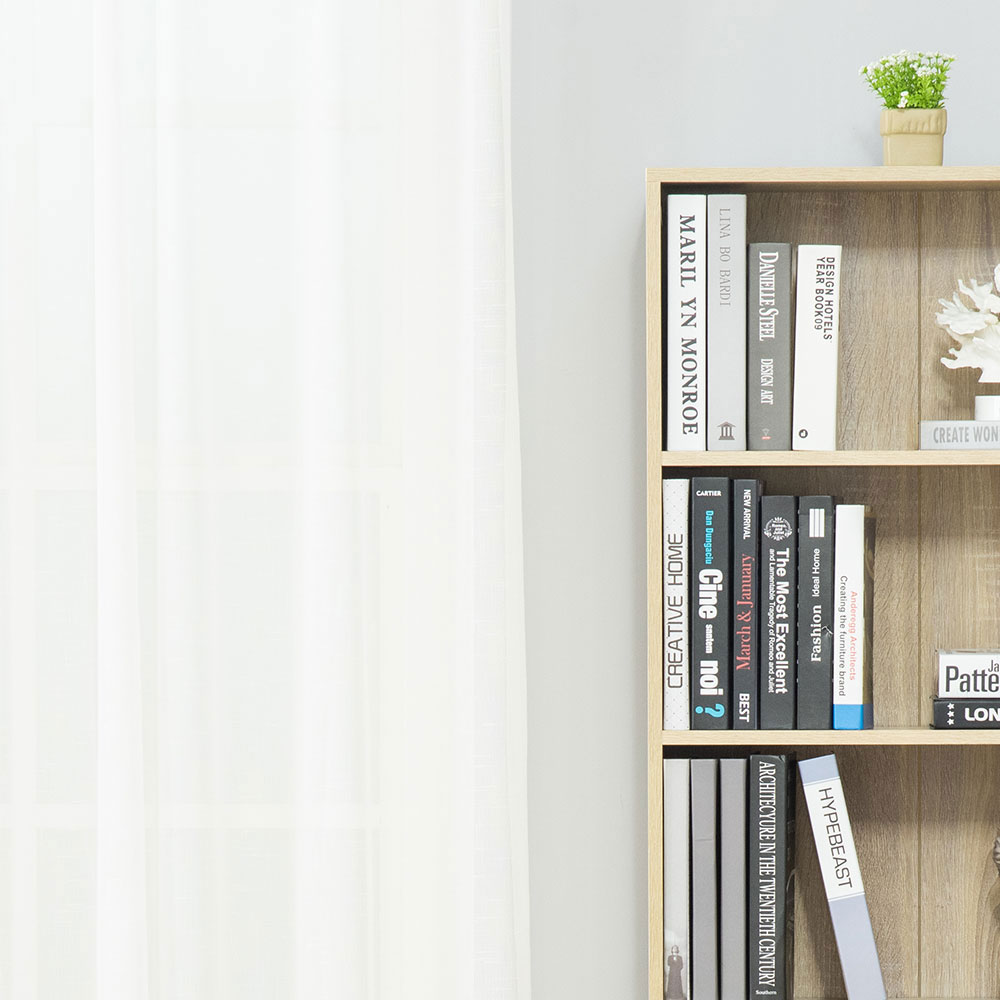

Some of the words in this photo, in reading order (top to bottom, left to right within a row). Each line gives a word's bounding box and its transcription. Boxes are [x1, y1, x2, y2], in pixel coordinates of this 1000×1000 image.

[720, 208, 730, 239] LINA
[680, 214, 696, 288] MARIL
[720, 246, 730, 262] BO
[720, 269, 731, 306] BARDI
[816, 257, 825, 284] YEAR
[825, 257, 835, 295] DESIGN
[680, 296, 696, 328] YN
[824, 300, 834, 340] HOTELS
[681, 338, 698, 434] MONROE
[761, 359, 773, 386] DESIGN
[761, 389, 773, 405] ART
[933, 427, 969, 443] CREATE
[743, 489, 751, 506] NEW
[706, 510, 714, 526] Dan
[743, 508, 751, 539] ARRIVAL
[668, 534, 683, 586] HOME
[704, 528, 714, 564] Dungaciu
[776, 548, 789, 577] The
[812, 548, 820, 575] Home
[698, 569, 723, 619] Cine
[736, 554, 755, 608] January
[812, 576, 820, 597] Ideal
[838, 576, 848, 612] Creating
[736, 610, 751, 622] &
[776, 582, 789, 619] Most
[848, 591, 858, 634] Anderegg
[668, 596, 683, 688] CREATIVE
[736, 624, 751, 670] March
[810, 604, 822, 662] Fashion
[839, 631, 847, 668] furniture
[775, 623, 789, 694] Excellent
[849, 636, 857, 680] Architects
[700, 660, 724, 696] noi
[738, 693, 750, 723] BEST
[759, 843, 776, 854] IN
[818, 787, 852, 888] HYPEBEAST
[759, 855, 776, 876] THE
[759, 878, 776, 937] TWENTIETH
[759, 938, 776, 987] CENTURY
